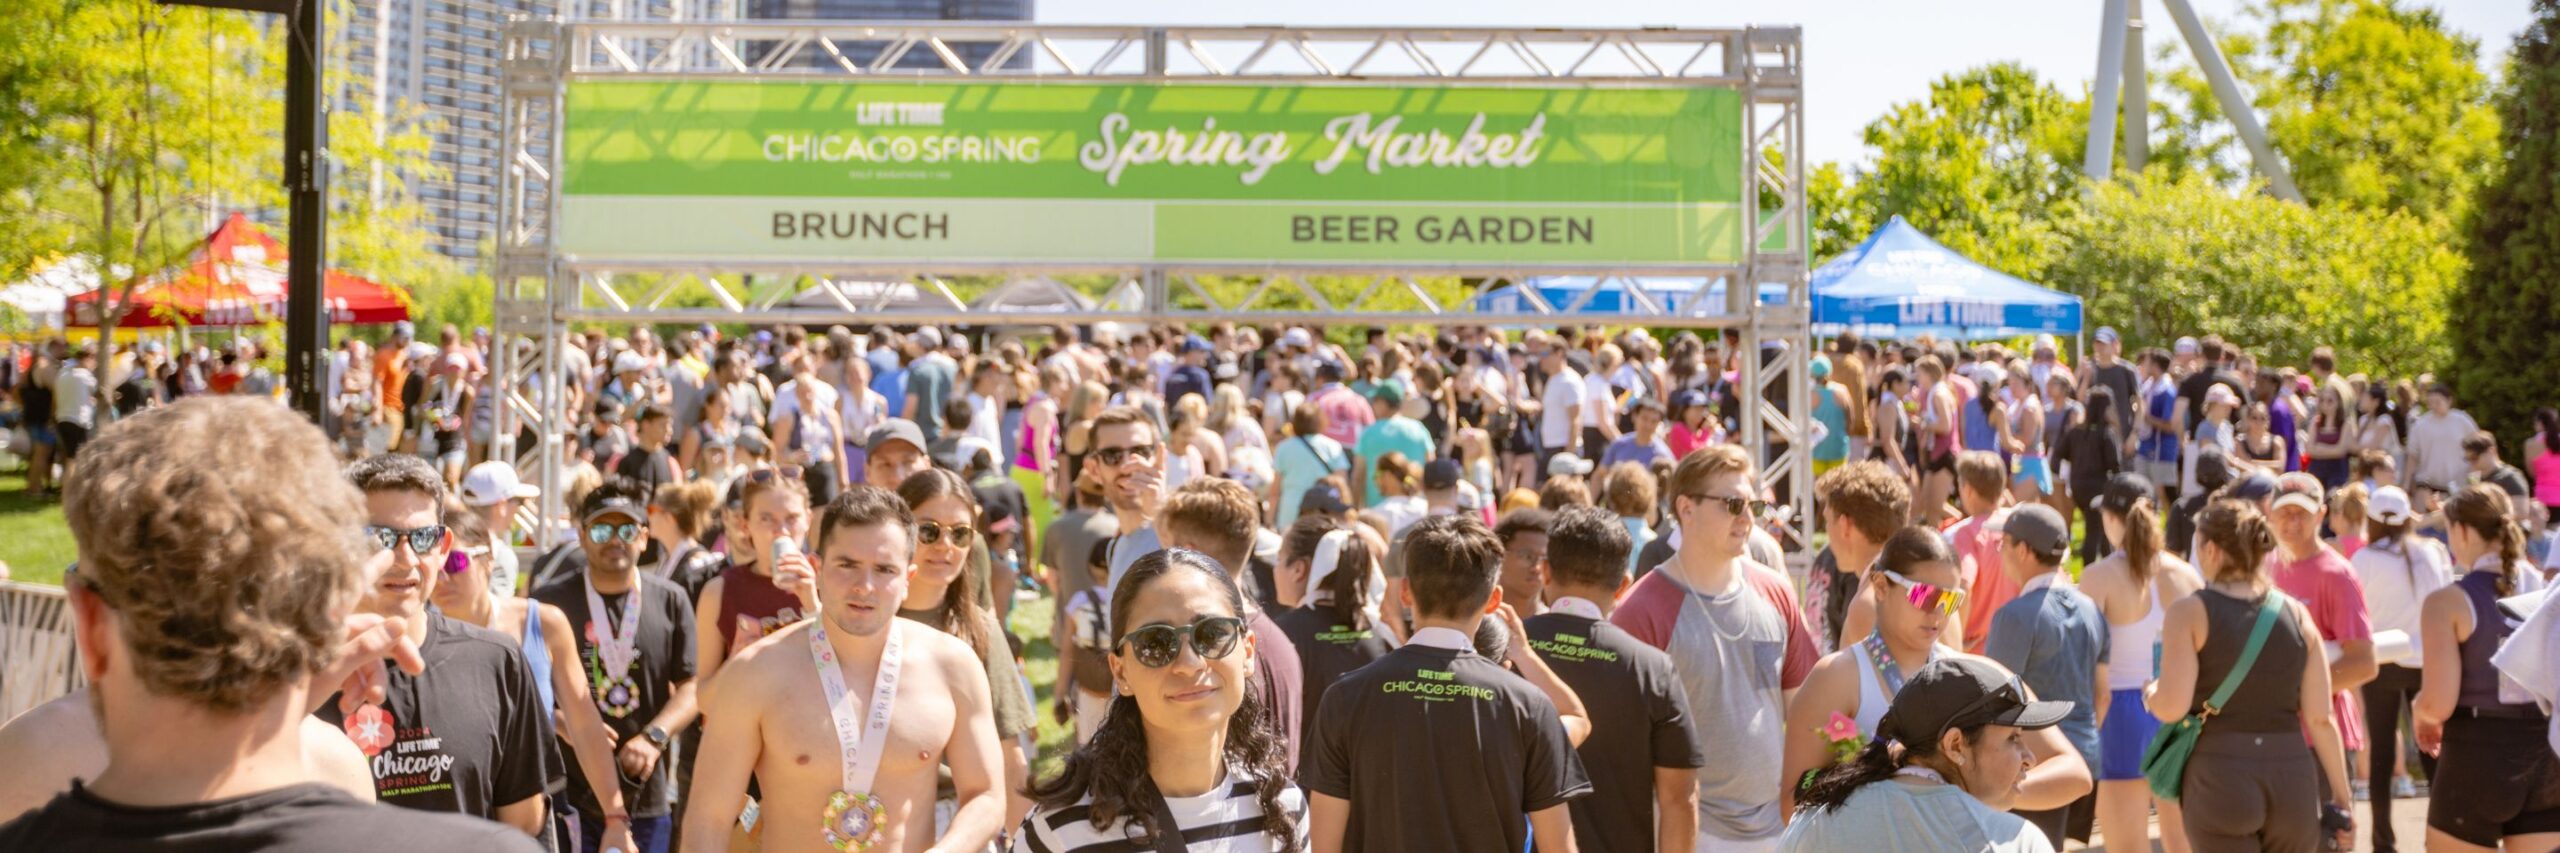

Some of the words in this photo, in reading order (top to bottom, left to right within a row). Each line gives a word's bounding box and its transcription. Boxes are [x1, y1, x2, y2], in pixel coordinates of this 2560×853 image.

[857, 103, 895, 125] LIFE
[898, 103, 945, 125] TIME
[763, 135, 917, 163] CHICAGO
[921, 136, 1041, 163] SPRING
[1079, 112, 1293, 187] Spring
[1314, 112, 1546, 175] Market
[772, 212, 949, 240] BRUNCH
[1291, 215, 1400, 243] BEER
[1415, 216, 1594, 244] GARDEN
[1898, 297, 1946, 325] LIFE
[1949, 298, 2006, 326] TIME
[1577, 647, 1617, 662] SPRING
[1383, 681, 1444, 695] CHICAGO
[1445, 684, 1494, 701] SPRING
[397, 740, 416, 754] LIFE
[373, 750, 455, 783] Chicago
[378, 775, 428, 789] SPRING
